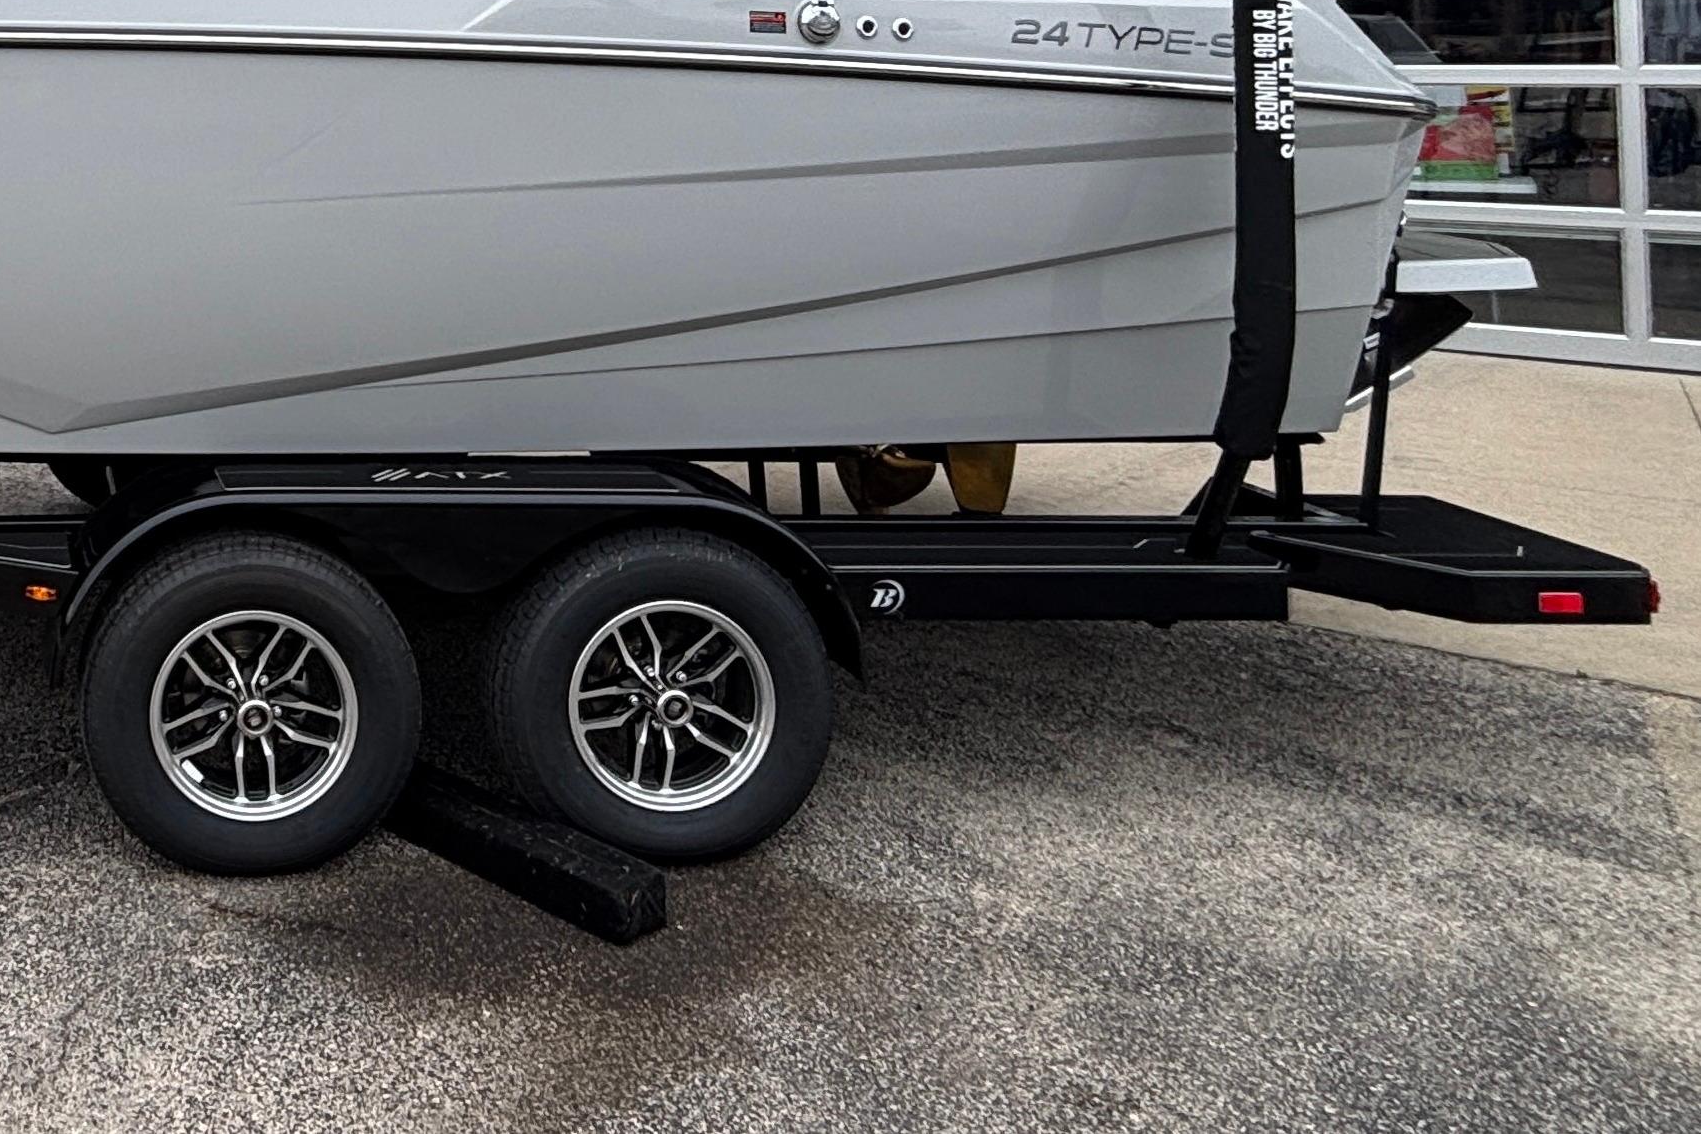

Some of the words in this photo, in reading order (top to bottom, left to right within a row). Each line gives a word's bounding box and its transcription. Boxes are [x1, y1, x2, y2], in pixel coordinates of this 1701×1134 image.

[1010, 19, 1070, 47] 24
[1252, 9, 1277, 31] BY
[1253, 32, 1278, 59] BIG
[1254, 60, 1280, 132] THUNDER
